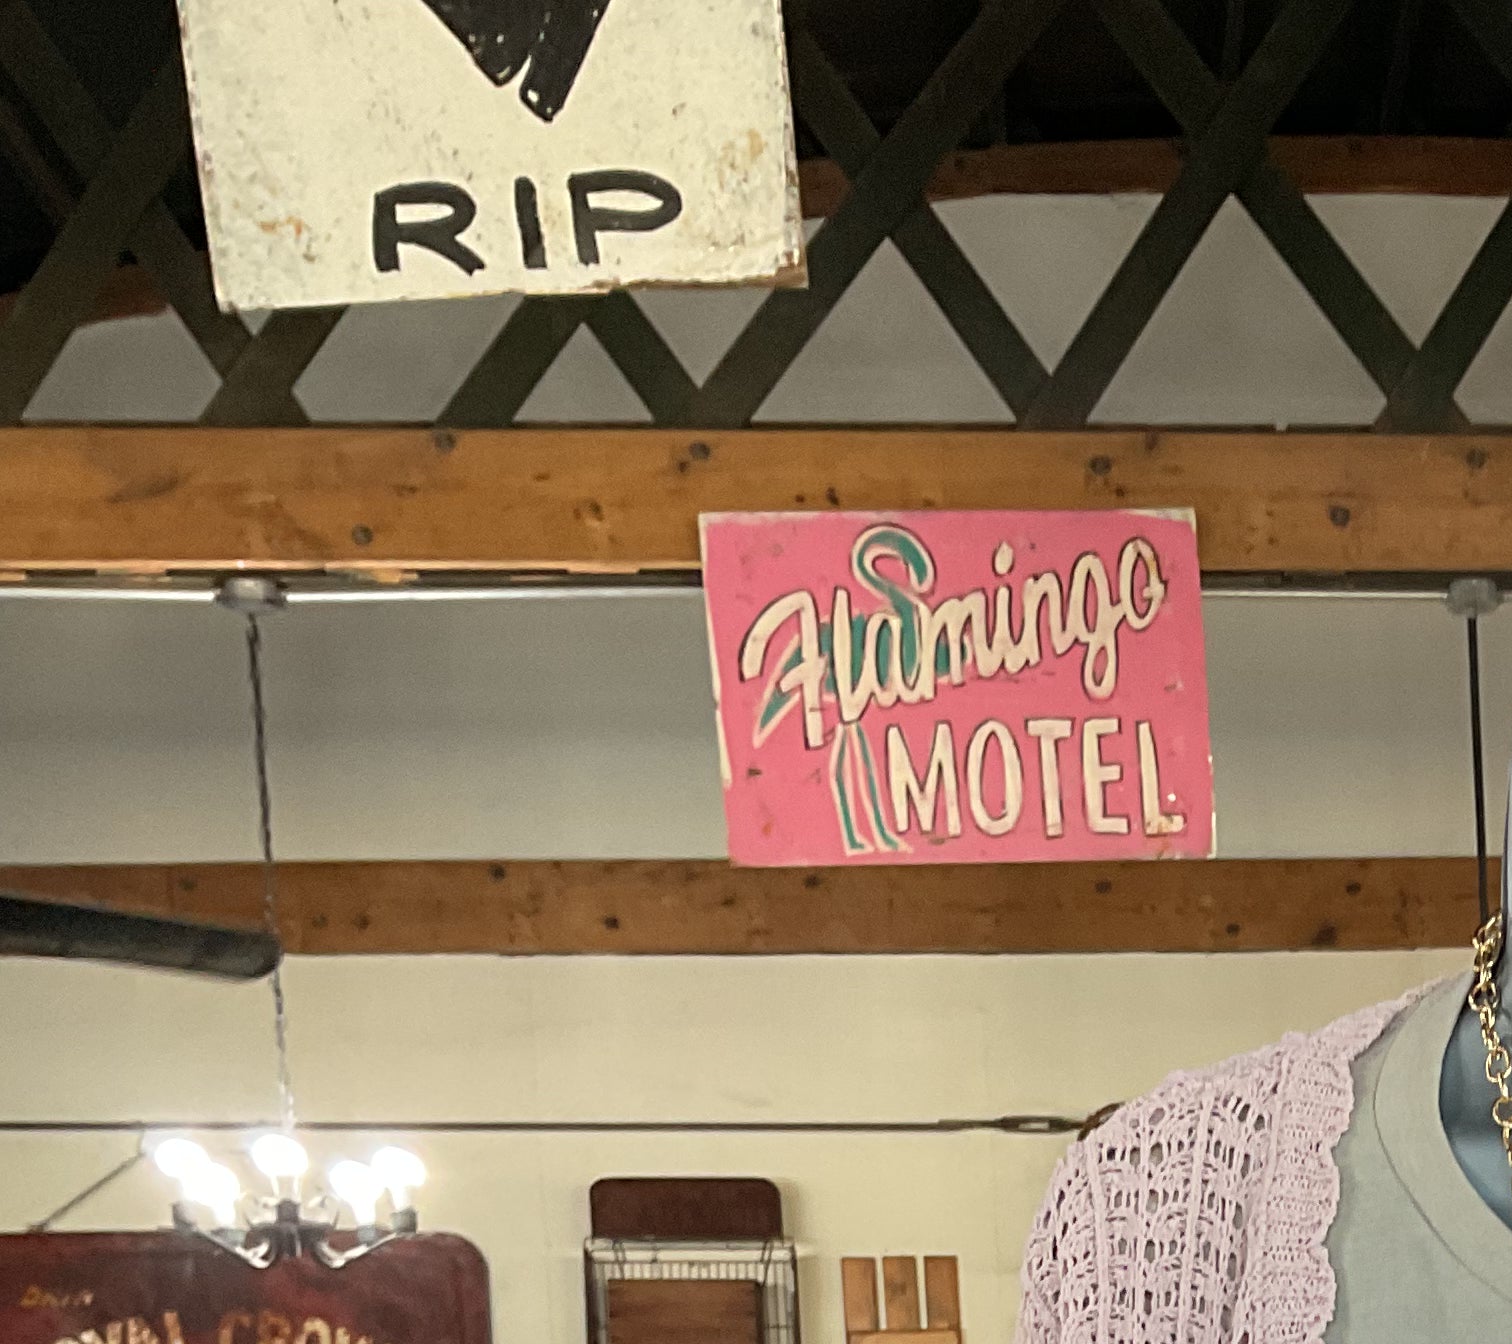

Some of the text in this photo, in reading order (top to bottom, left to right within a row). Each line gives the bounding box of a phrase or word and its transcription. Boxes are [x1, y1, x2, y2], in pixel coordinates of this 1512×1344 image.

[372, 169, 682, 276] RIP
[738, 536, 1169, 751] Flamingo
[886, 717, 1186, 838] MOTEL
